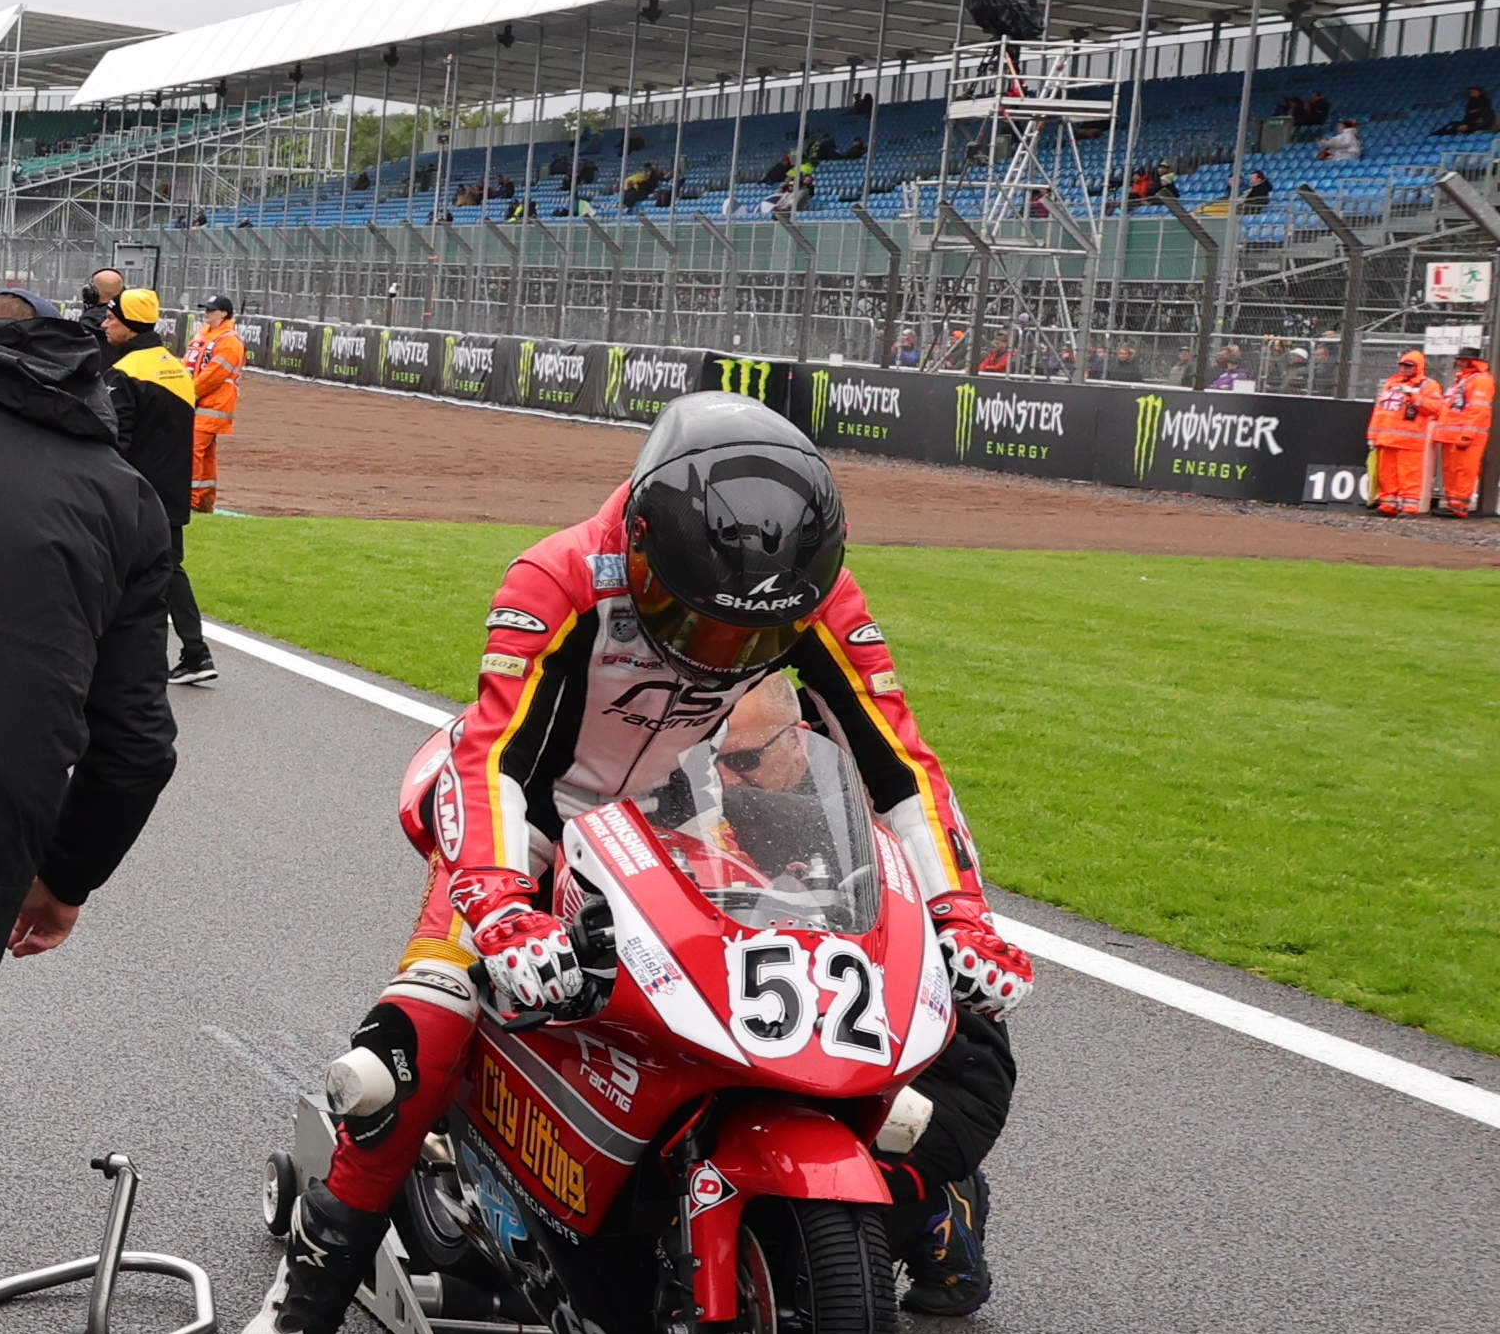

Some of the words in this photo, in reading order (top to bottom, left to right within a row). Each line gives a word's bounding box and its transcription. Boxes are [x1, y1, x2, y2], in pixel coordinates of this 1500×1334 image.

[331, 334, 367, 360] MONSTER
[386, 340, 430, 367] MONSTER
[391, 371, 422, 385] ENERGY
[532, 351, 585, 386] MONSTER
[623, 358, 689, 393] MONSTER
[538, 389, 576, 404] ENERGY
[828, 376, 901, 418] MONSTER
[837, 422, 889, 440] ENERGY
[975, 391, 1064, 438] MONSTER
[1161, 404, 1284, 456] MONSTER
[986, 440, 1051, 461] ENERGY
[1172, 458, 1248, 481] ENERGY
[714, 590, 804, 613] SHARK
[618, 657, 664, 669] SHARK
[602, 707, 715, 731] racing
[584, 812, 608, 842] OFFICE
[604, 832, 640, 878] FURNITURE
[599, 803, 660, 871] YORKSHIRE
[627, 935, 663, 978] British
[741, 946, 886, 1055] 52
[390, 1048, 412, 1083] R&G
[579, 1061, 633, 1114] racing
[480, 1053, 520, 1150] City
[519, 1095, 589, 1215] Lifting
[696, 1178, 722, 1195] D
[511, 1181, 580, 1247] SPECIALISTS
